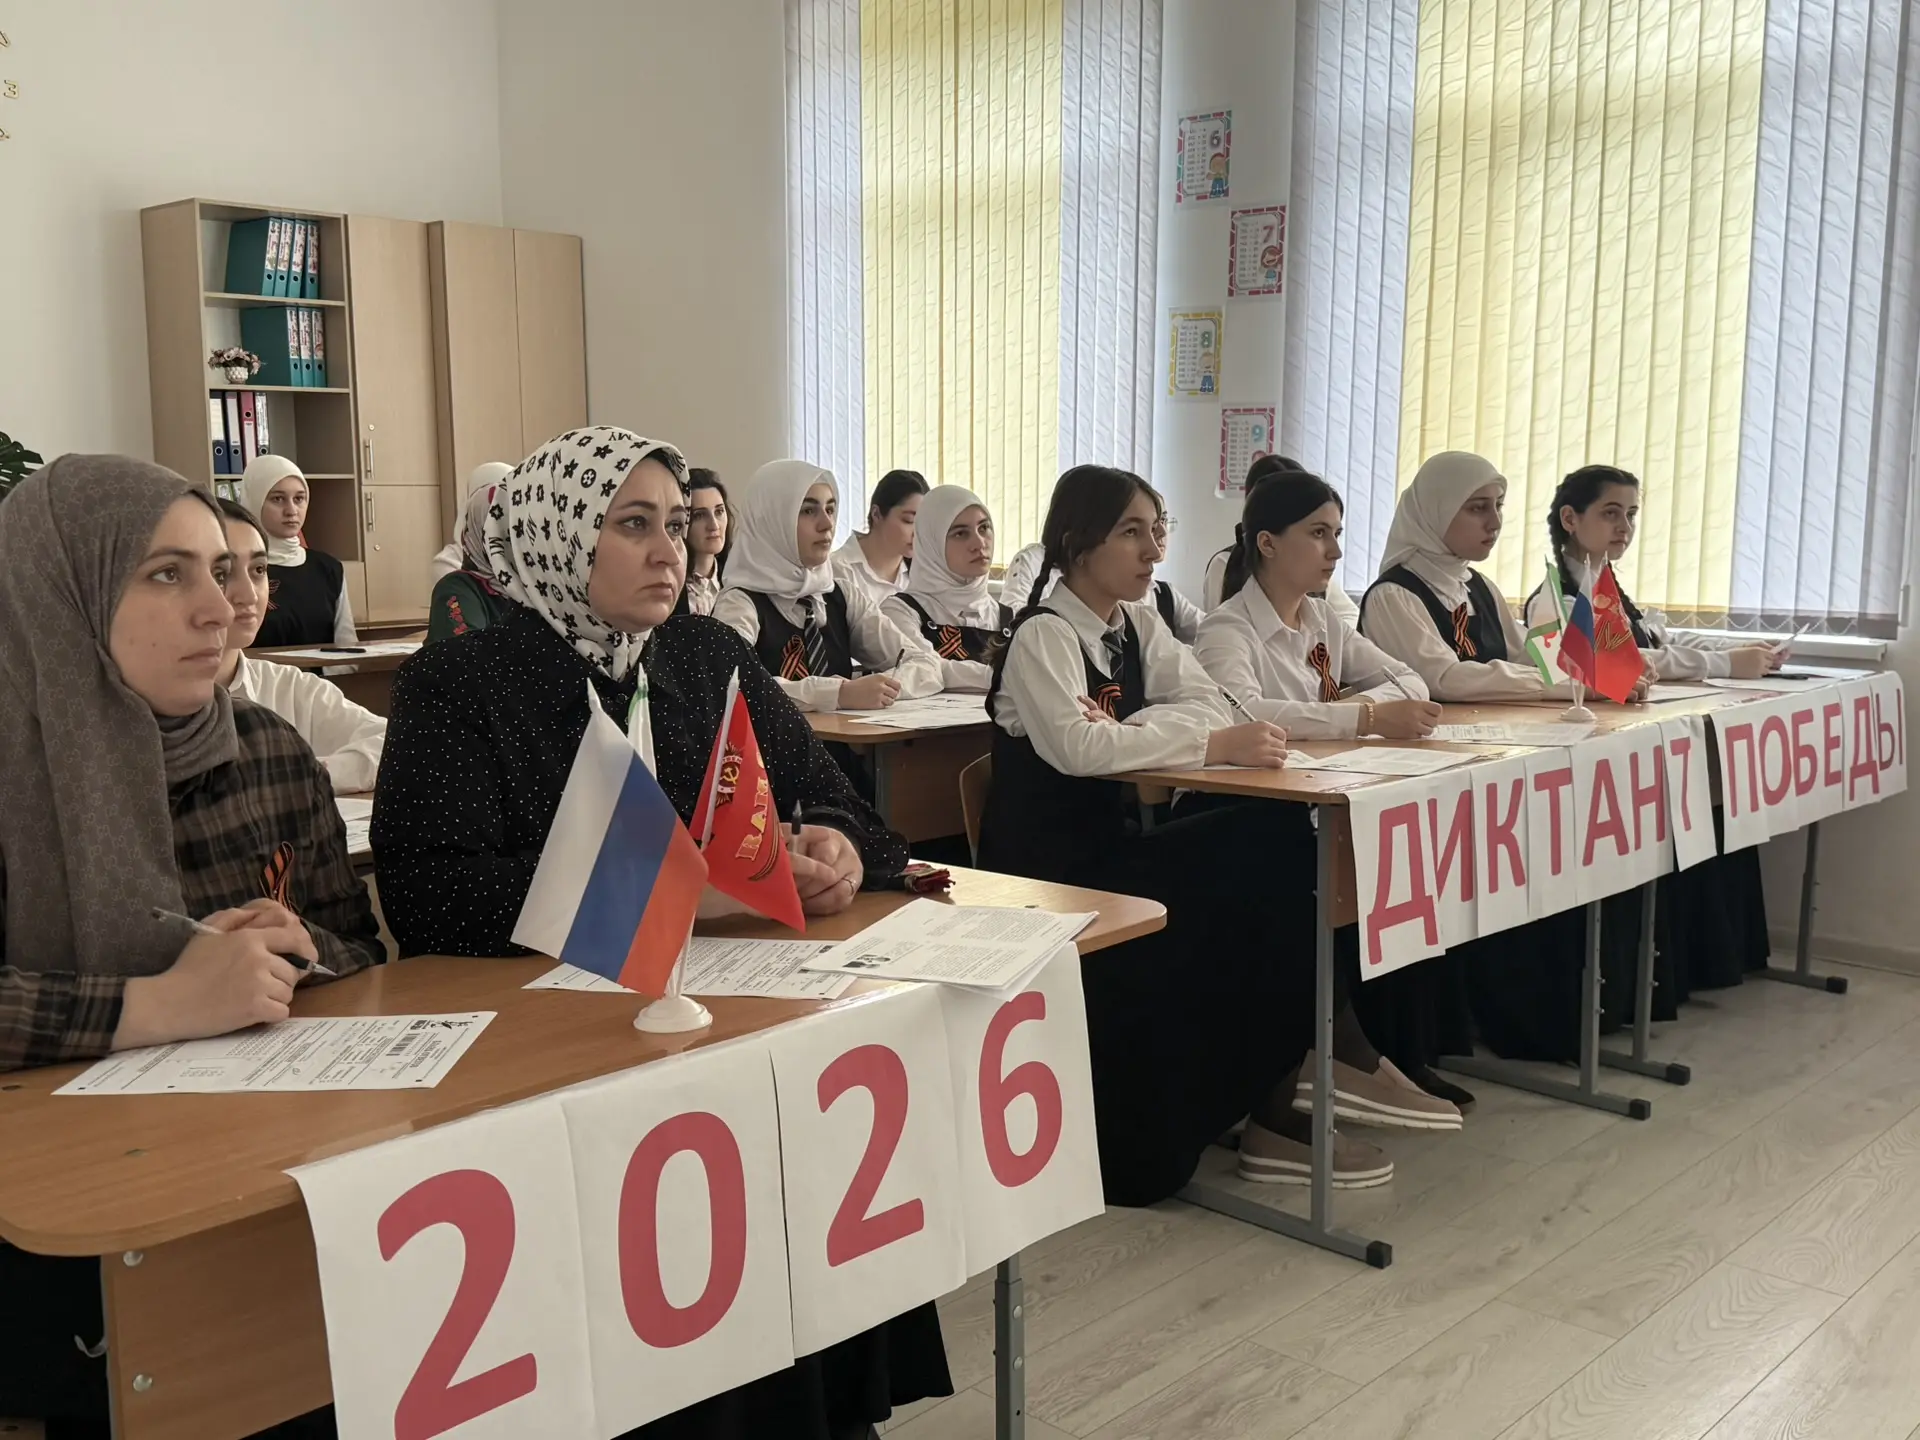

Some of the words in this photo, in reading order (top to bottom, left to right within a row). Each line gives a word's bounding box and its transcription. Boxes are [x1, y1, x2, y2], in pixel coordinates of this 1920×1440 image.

[1210, 130, 1222, 149] 6
[1263, 225, 1275, 244] 7
[1201, 331, 1213, 348] 8
[1252, 425, 1264, 443] 9
[1725, 688, 1902, 818] ПОБЕДЫ
[377, 991, 1063, 1440] 2026
